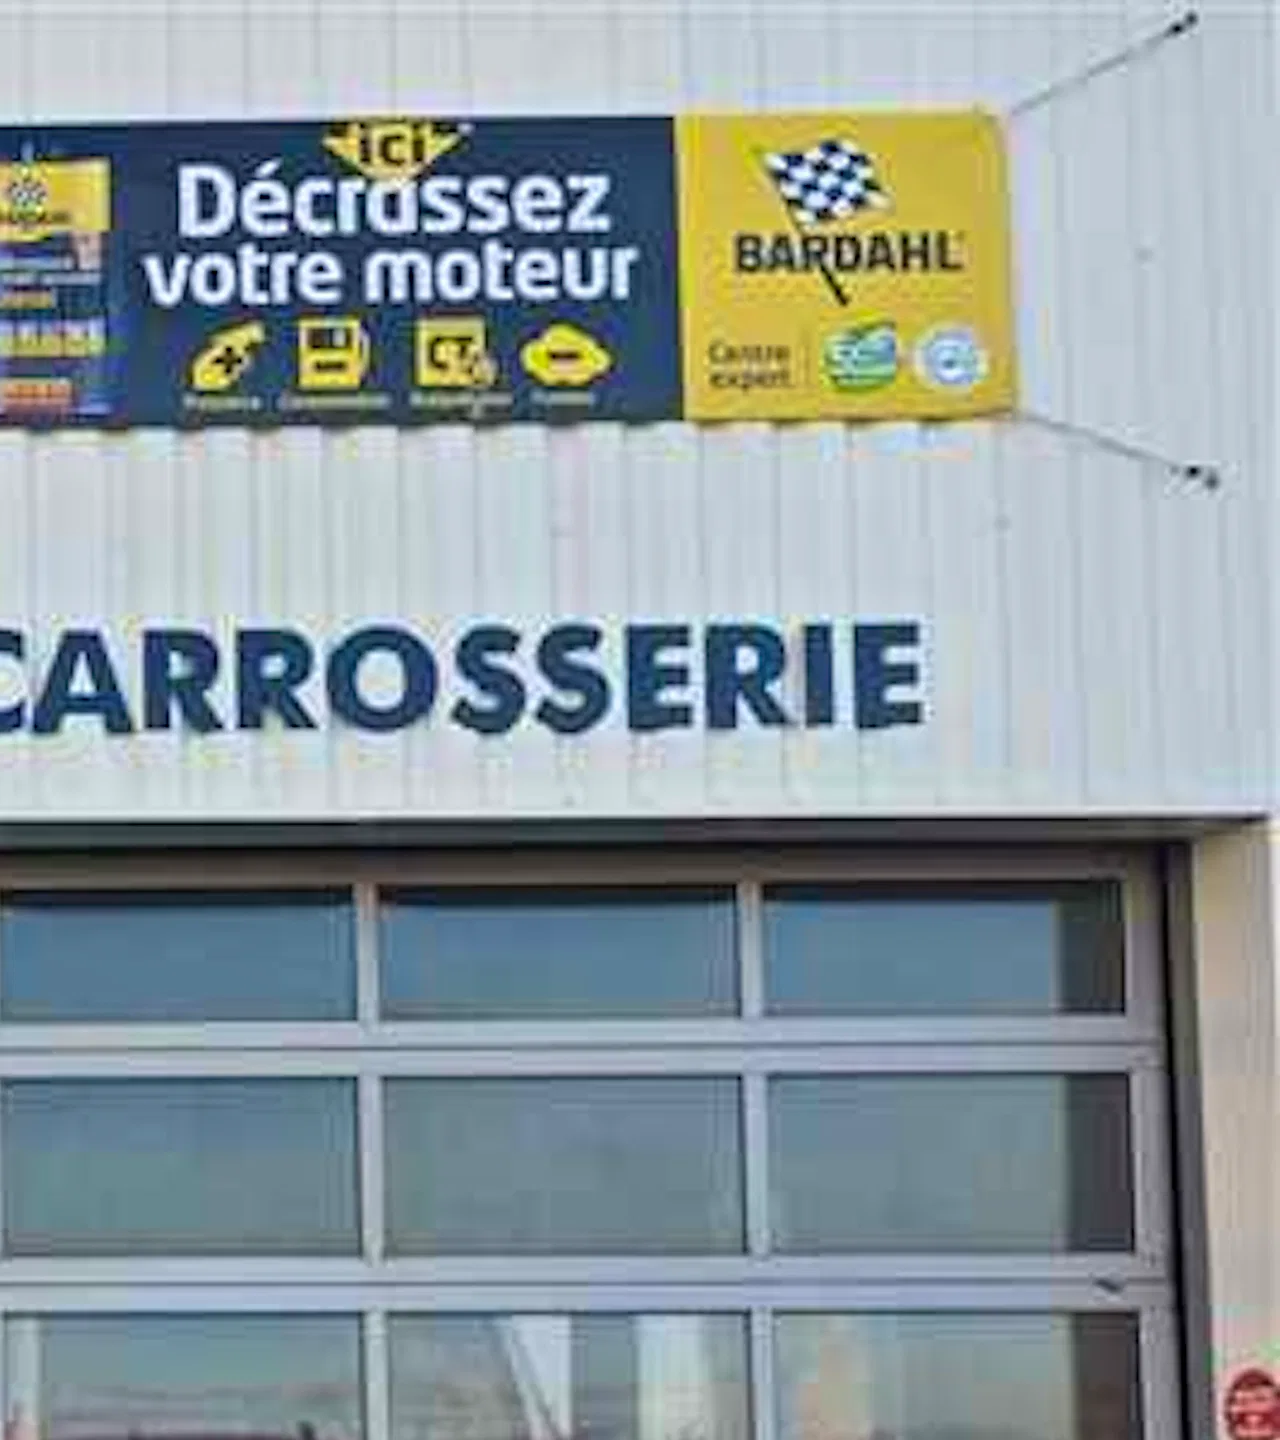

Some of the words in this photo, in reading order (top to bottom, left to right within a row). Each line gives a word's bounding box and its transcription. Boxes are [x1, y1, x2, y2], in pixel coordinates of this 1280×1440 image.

[176, 159, 612, 238] Décrassez
[143, 244, 341, 305] votre
[366, 240, 640, 303] moteur
[732, 230, 964, 273] BARDAHL
